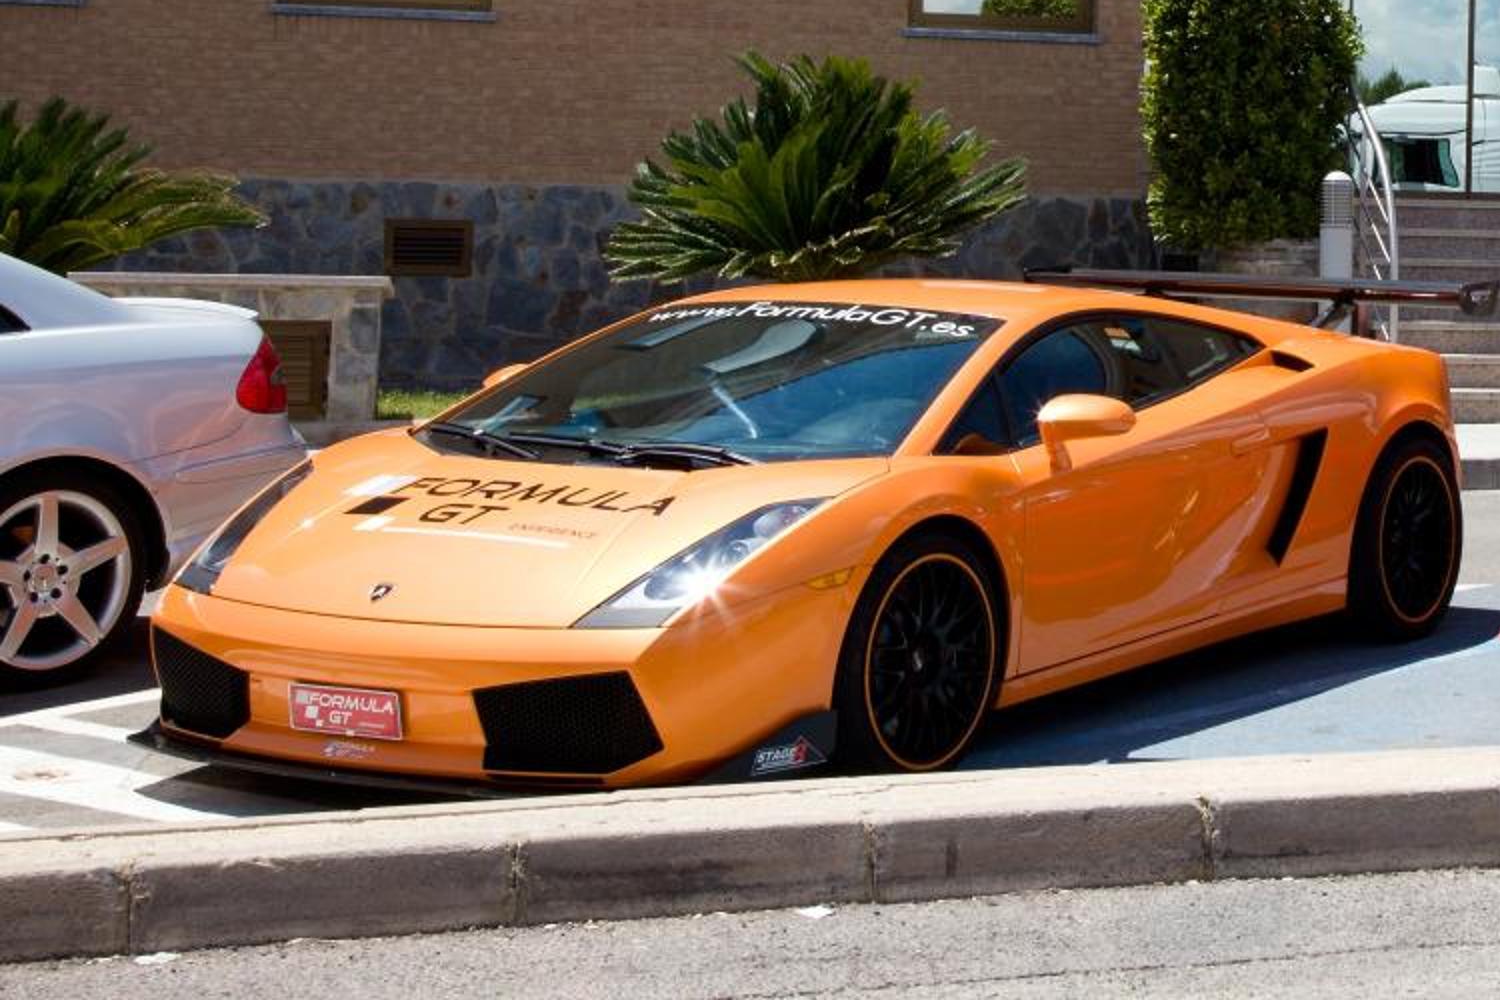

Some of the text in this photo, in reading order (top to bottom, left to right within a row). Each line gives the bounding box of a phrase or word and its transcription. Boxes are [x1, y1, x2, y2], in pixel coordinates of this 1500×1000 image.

[649, 300, 976, 338] www.FormulaGT.es
[388, 476, 678, 517] FORMULA
[418, 502, 511, 525] GT
[308, 692, 394, 715] FORMULA
[328, 709, 353, 725] GT
